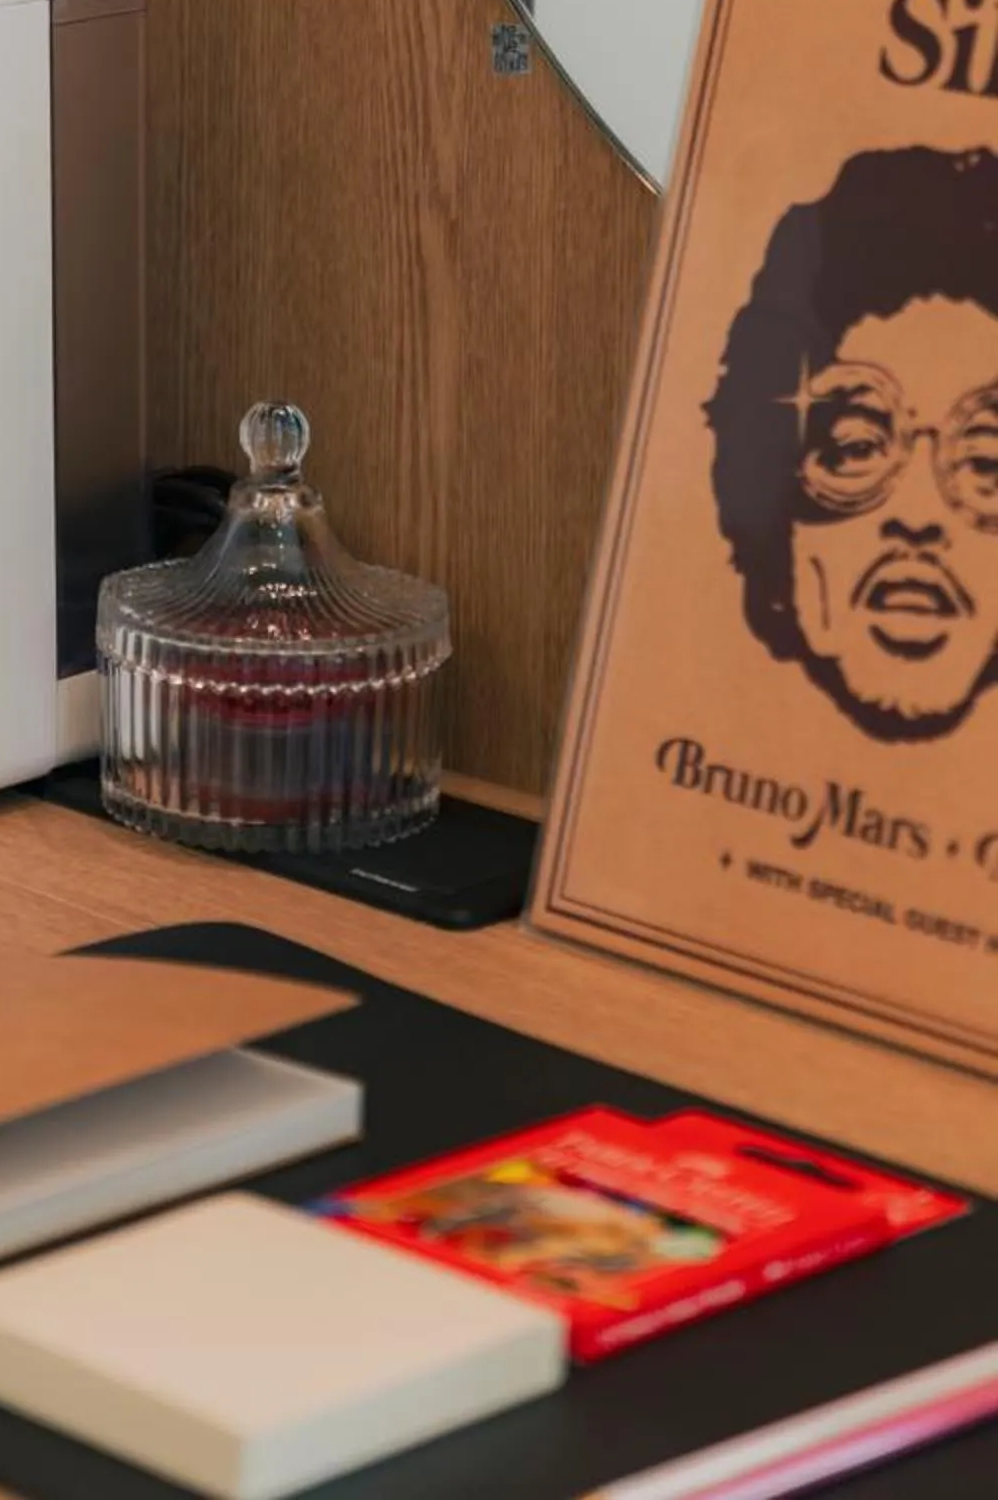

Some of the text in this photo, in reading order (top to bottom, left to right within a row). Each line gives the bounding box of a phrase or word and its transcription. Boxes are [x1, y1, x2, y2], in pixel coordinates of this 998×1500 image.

[654, 736, 809, 822] Bruno
[788, 781, 930, 860] Mars
[746, 861, 803, 892] WITH
[807, 879, 897, 925] SPECIAL
[904, 907, 981, 948] GUEST
